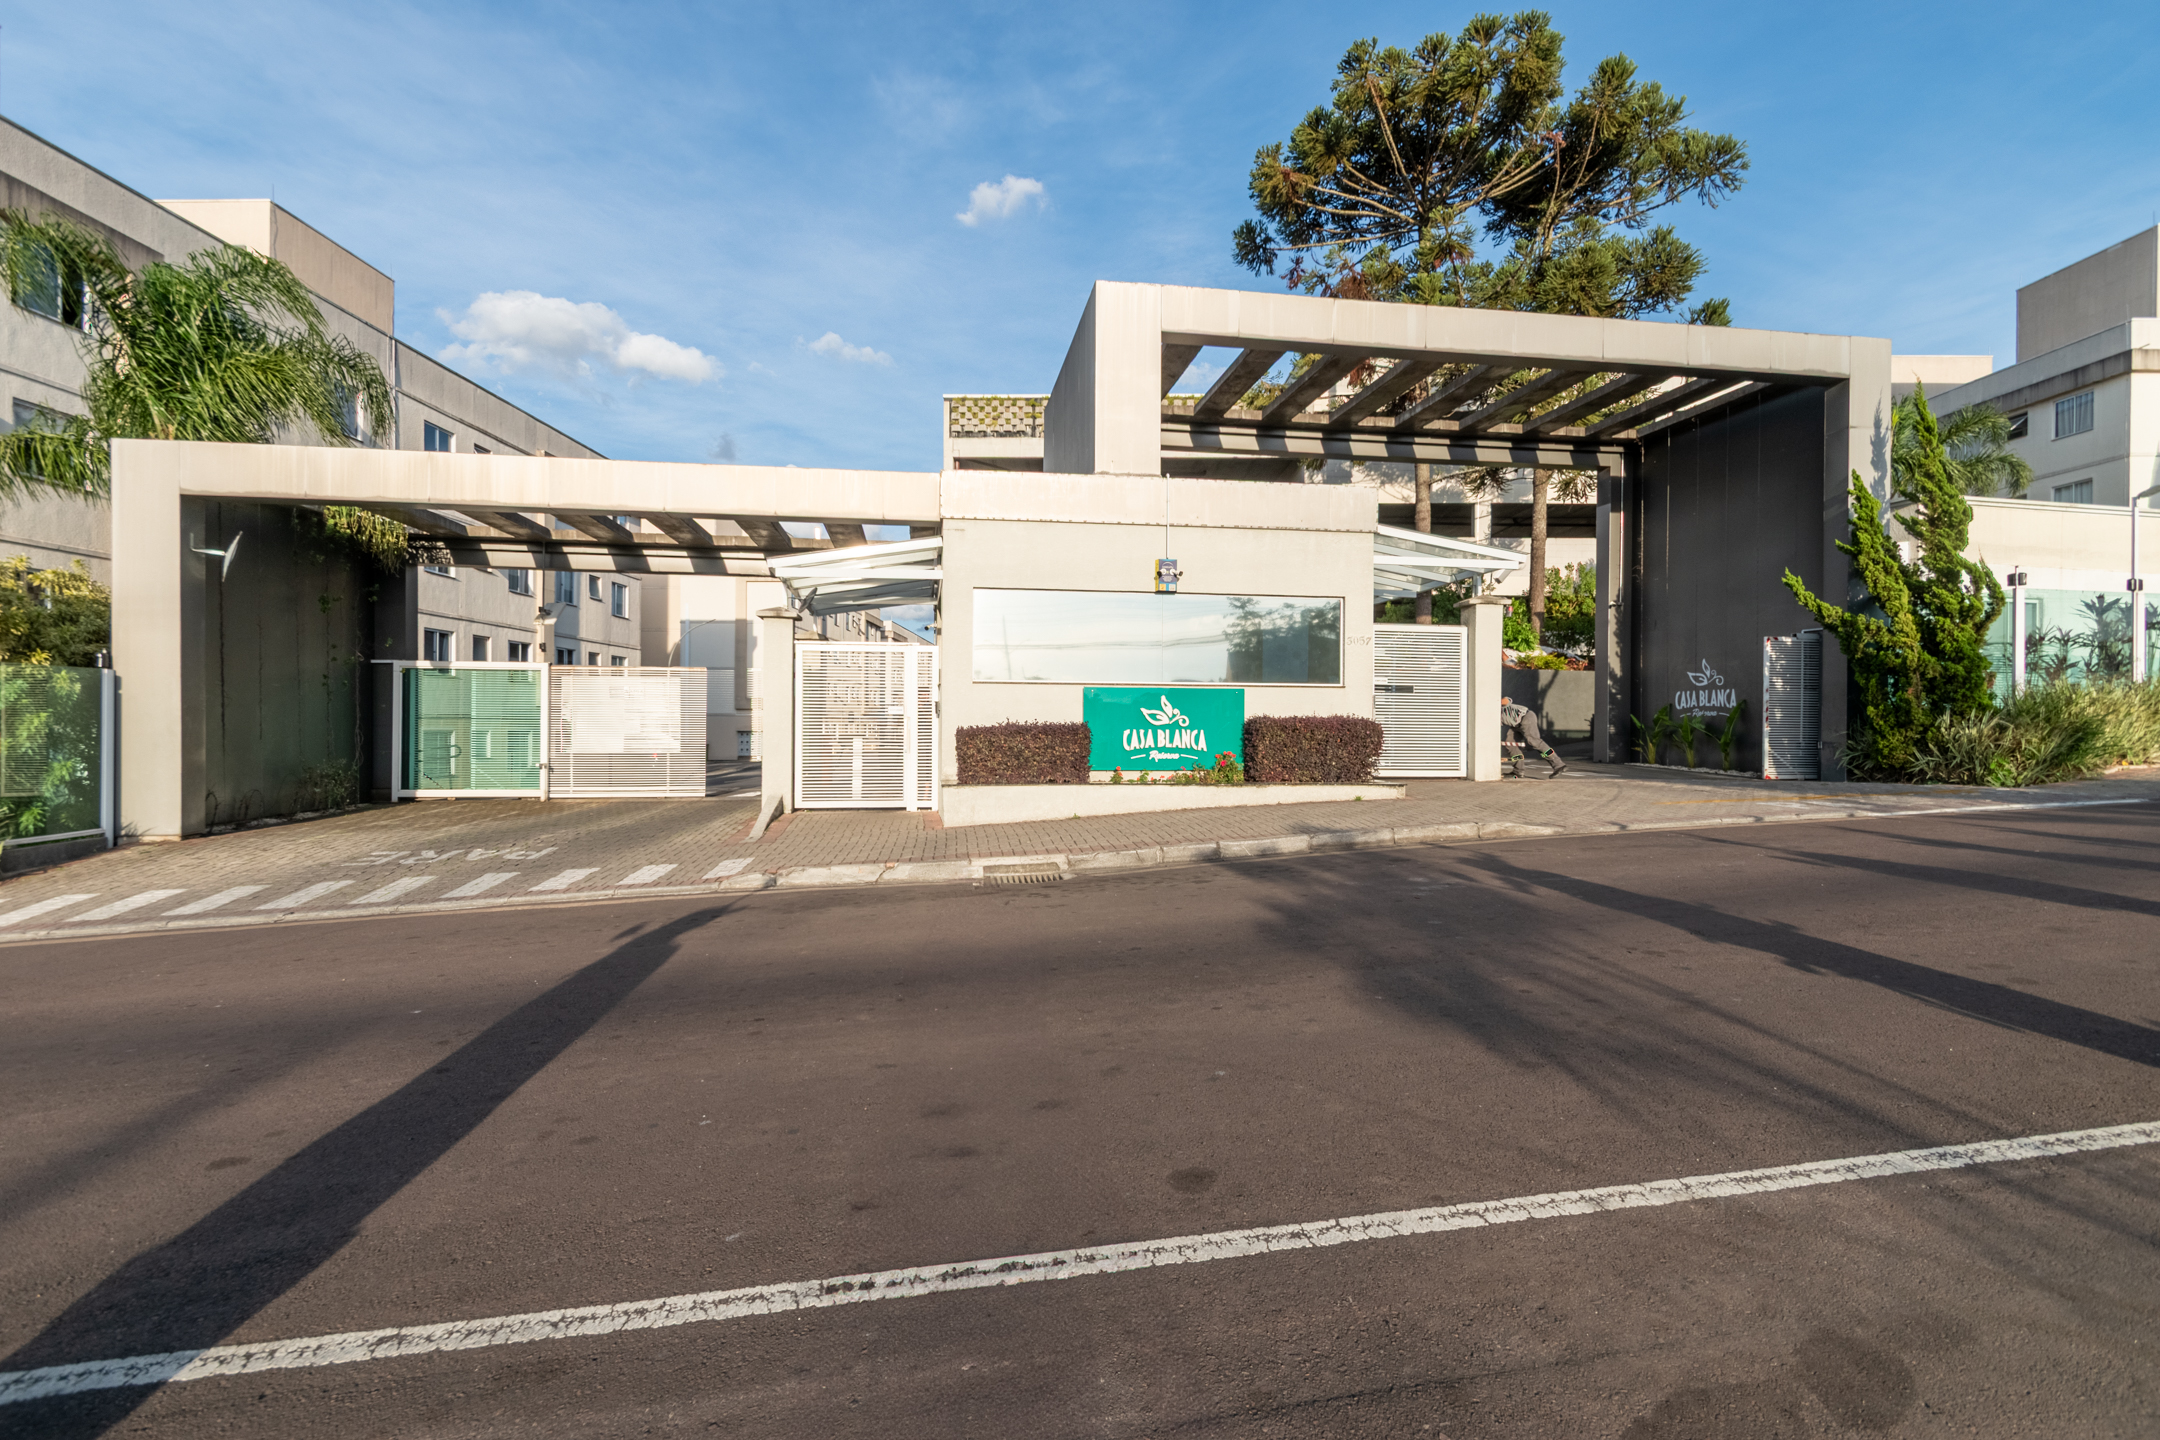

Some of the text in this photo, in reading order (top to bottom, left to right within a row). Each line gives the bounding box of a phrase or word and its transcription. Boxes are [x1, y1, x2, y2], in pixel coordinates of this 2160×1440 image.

[1675, 688, 1737, 710] CASA BLANCA
[1122, 728, 1208, 752] CASA BLANCA
[338, 846, 560, 867] PARE
